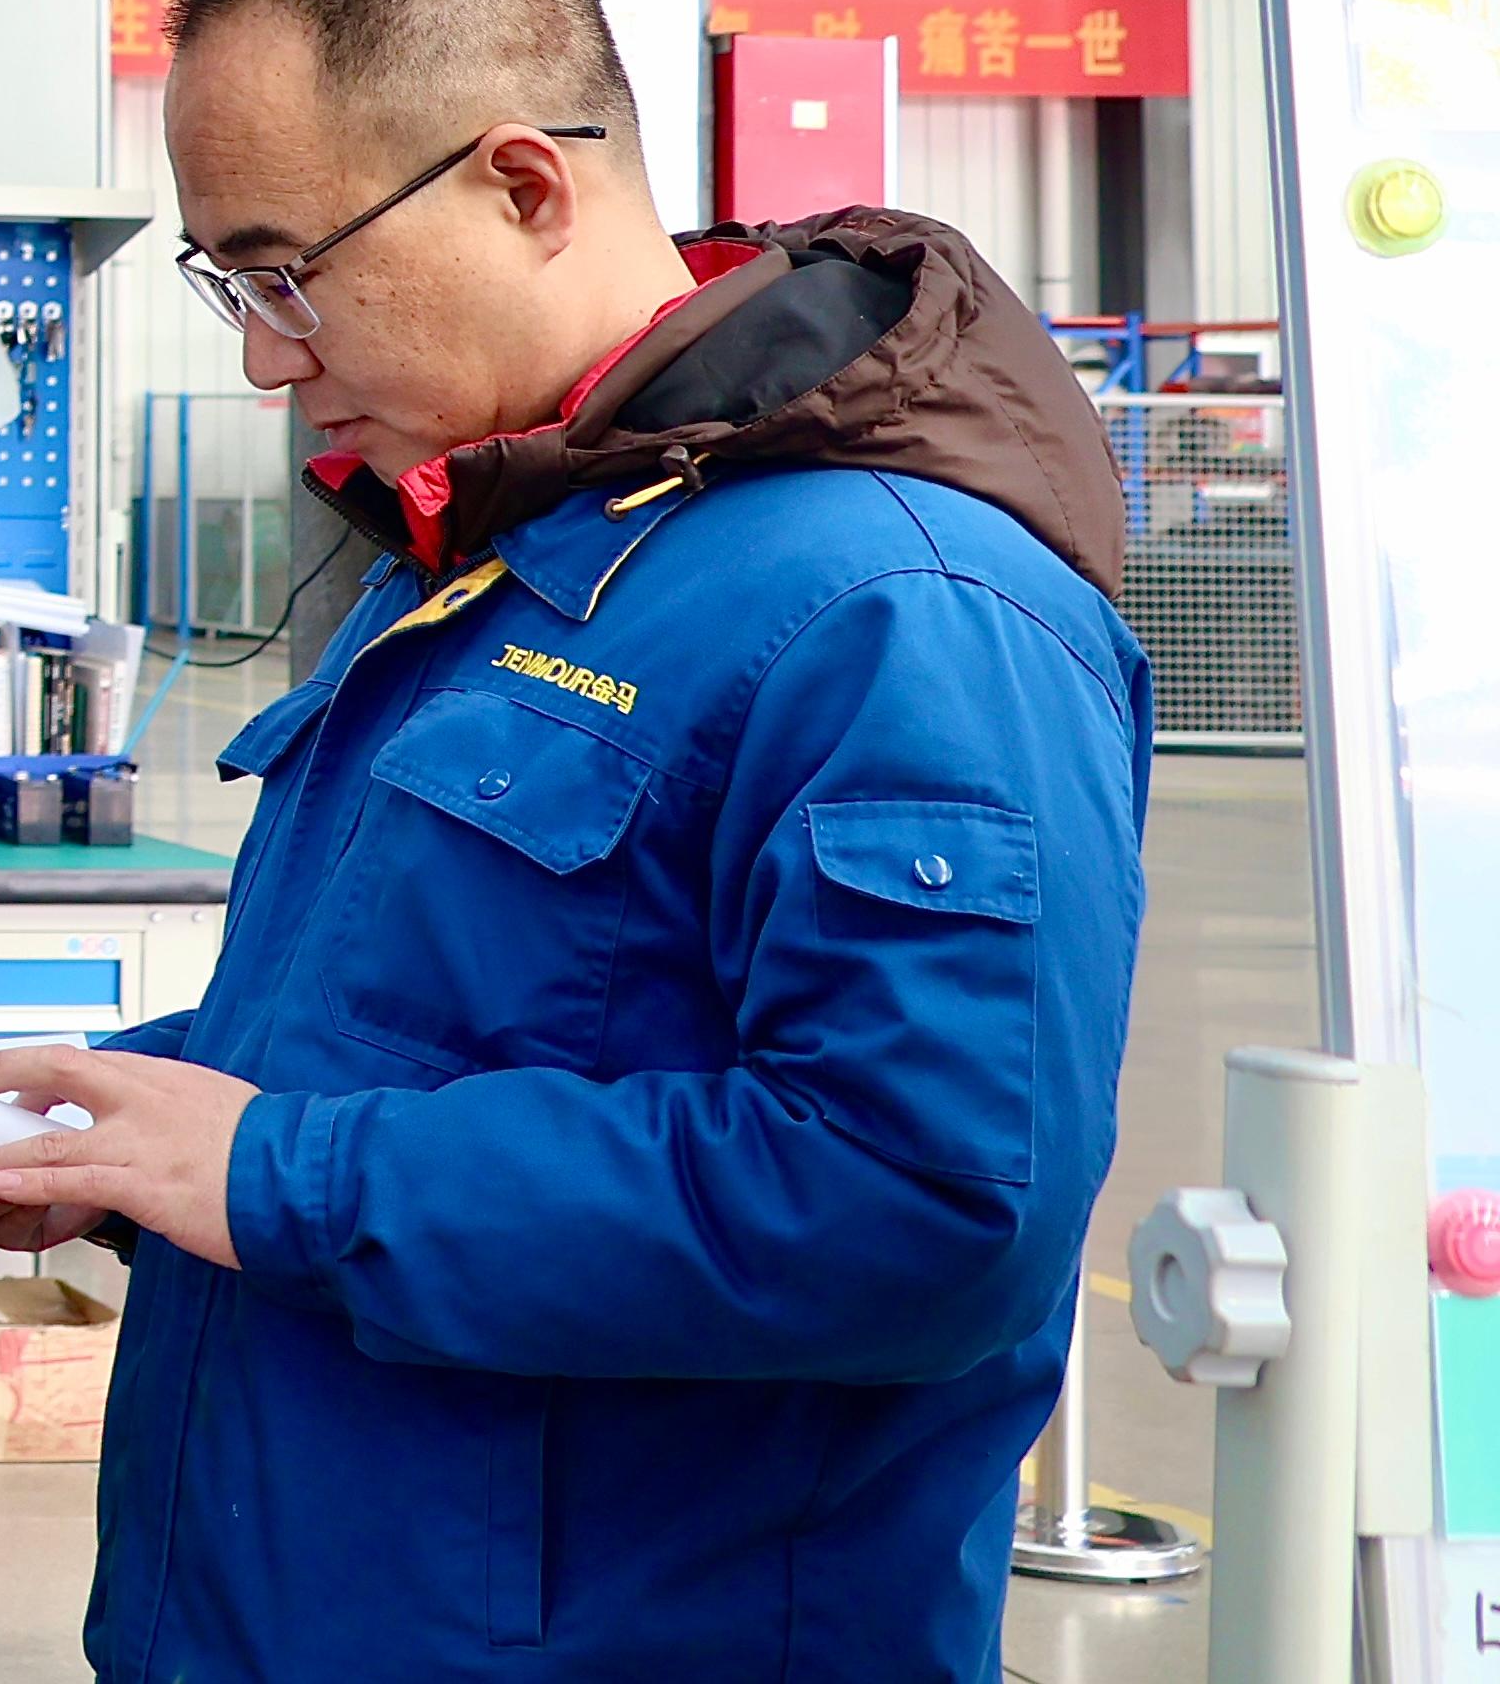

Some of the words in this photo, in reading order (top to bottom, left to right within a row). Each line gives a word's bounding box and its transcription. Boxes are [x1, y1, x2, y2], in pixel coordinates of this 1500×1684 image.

[918, 8, 1128, 78] 痛苦一世
[491, 644, 639, 715] JENMOUR金马
